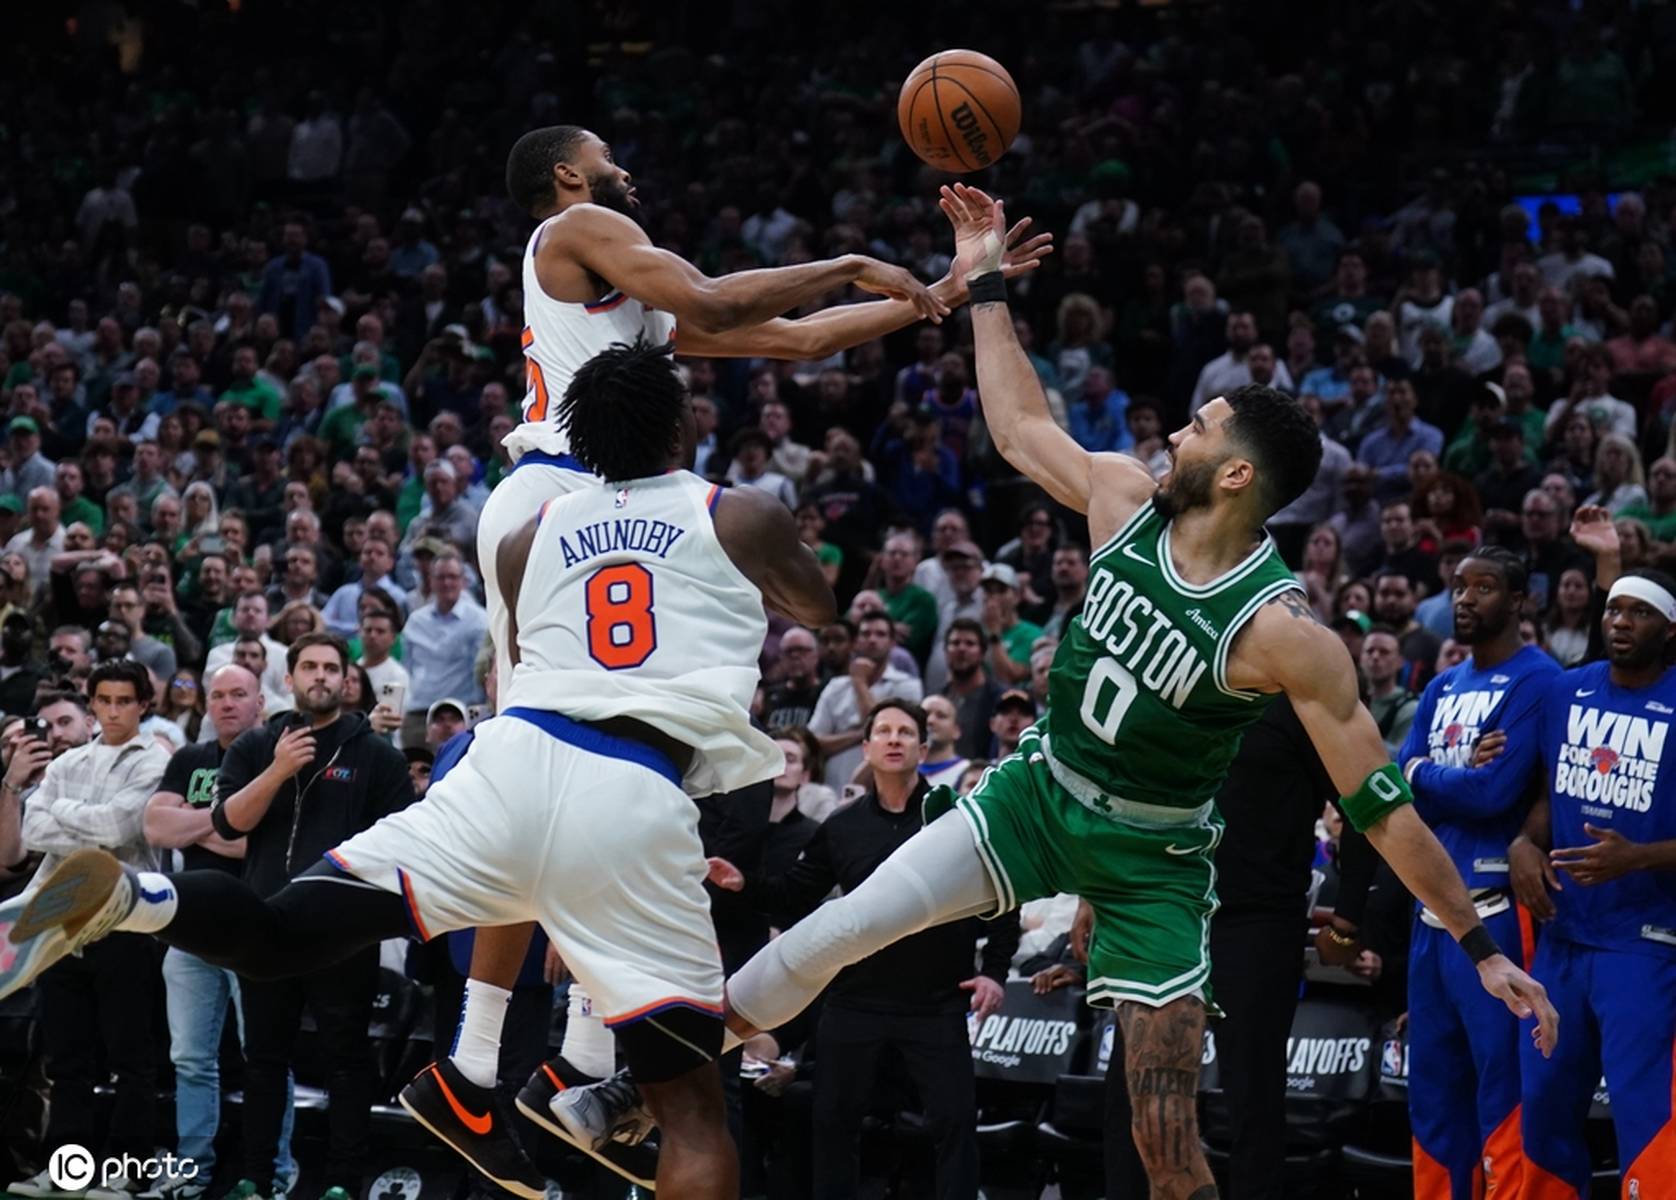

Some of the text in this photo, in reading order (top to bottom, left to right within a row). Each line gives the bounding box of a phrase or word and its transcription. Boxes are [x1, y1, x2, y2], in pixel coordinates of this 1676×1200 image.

[559, 519, 685, 568] ANUNOBY
[585, 561, 657, 671] 8
[1082, 567, 1208, 710] BOSTON
[1185, 607, 1219, 640] Amica
[1080, 656, 1138, 746] 0
[1430, 690, 1505, 733] WIN
[1567, 704, 1669, 763] WIN
[1558, 743, 1659, 782] FOR THE
[1555, 762, 1655, 813] BOROUGHS
[975, 1014, 1077, 1055] PLAYOFFS
[982, 1050, 1021, 1068] Google
